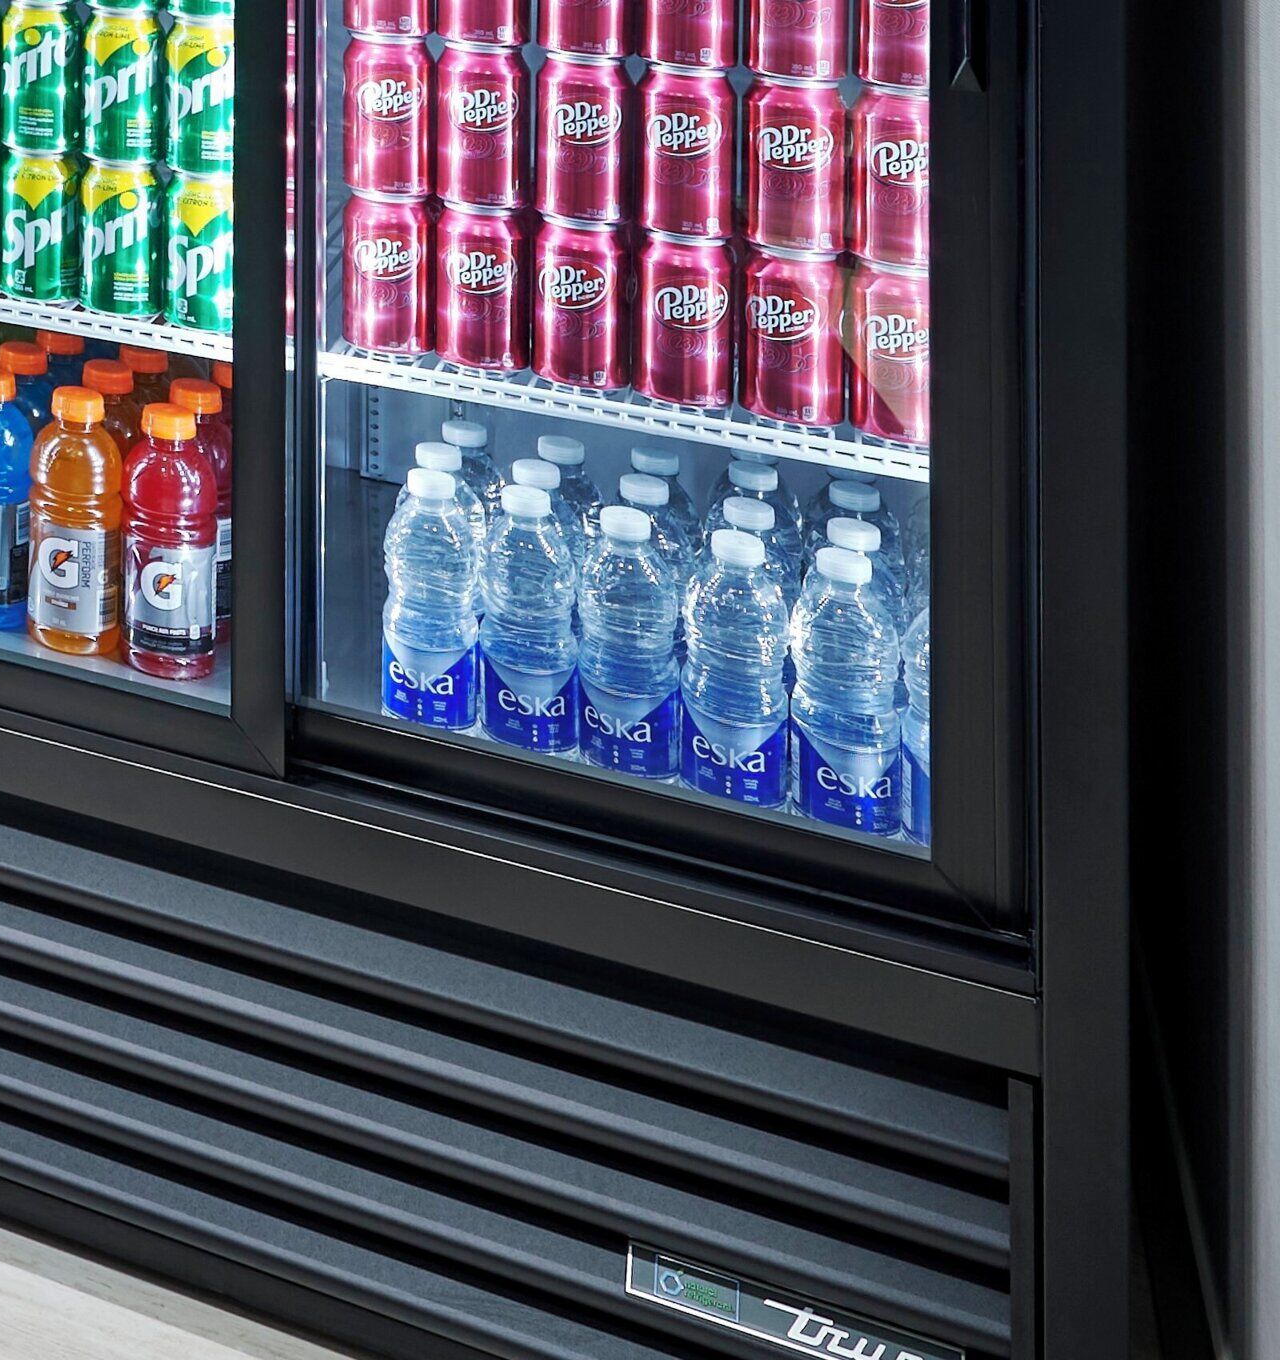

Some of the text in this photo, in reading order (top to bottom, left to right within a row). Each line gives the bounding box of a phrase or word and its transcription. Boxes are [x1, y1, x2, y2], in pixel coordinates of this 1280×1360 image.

[758, 127, 827, 164] Pepper
[783, 125, 811, 143] Dr
[540, 266, 604, 302] Pepper
[559, 266, 587, 283] Dr
[750, 296, 812, 333] Pepper
[767, 296, 795, 312] Dr
[39, 537, 80, 589] G
[81, 541, 91, 589] PERFORM
[141, 561, 183, 611] G
[389, 660, 454, 695] eska
[498, 689, 565, 717] eska
[585, 705, 652, 743] eska
[692, 735, 766, 773] eska
[817, 766, 892, 799] eska
